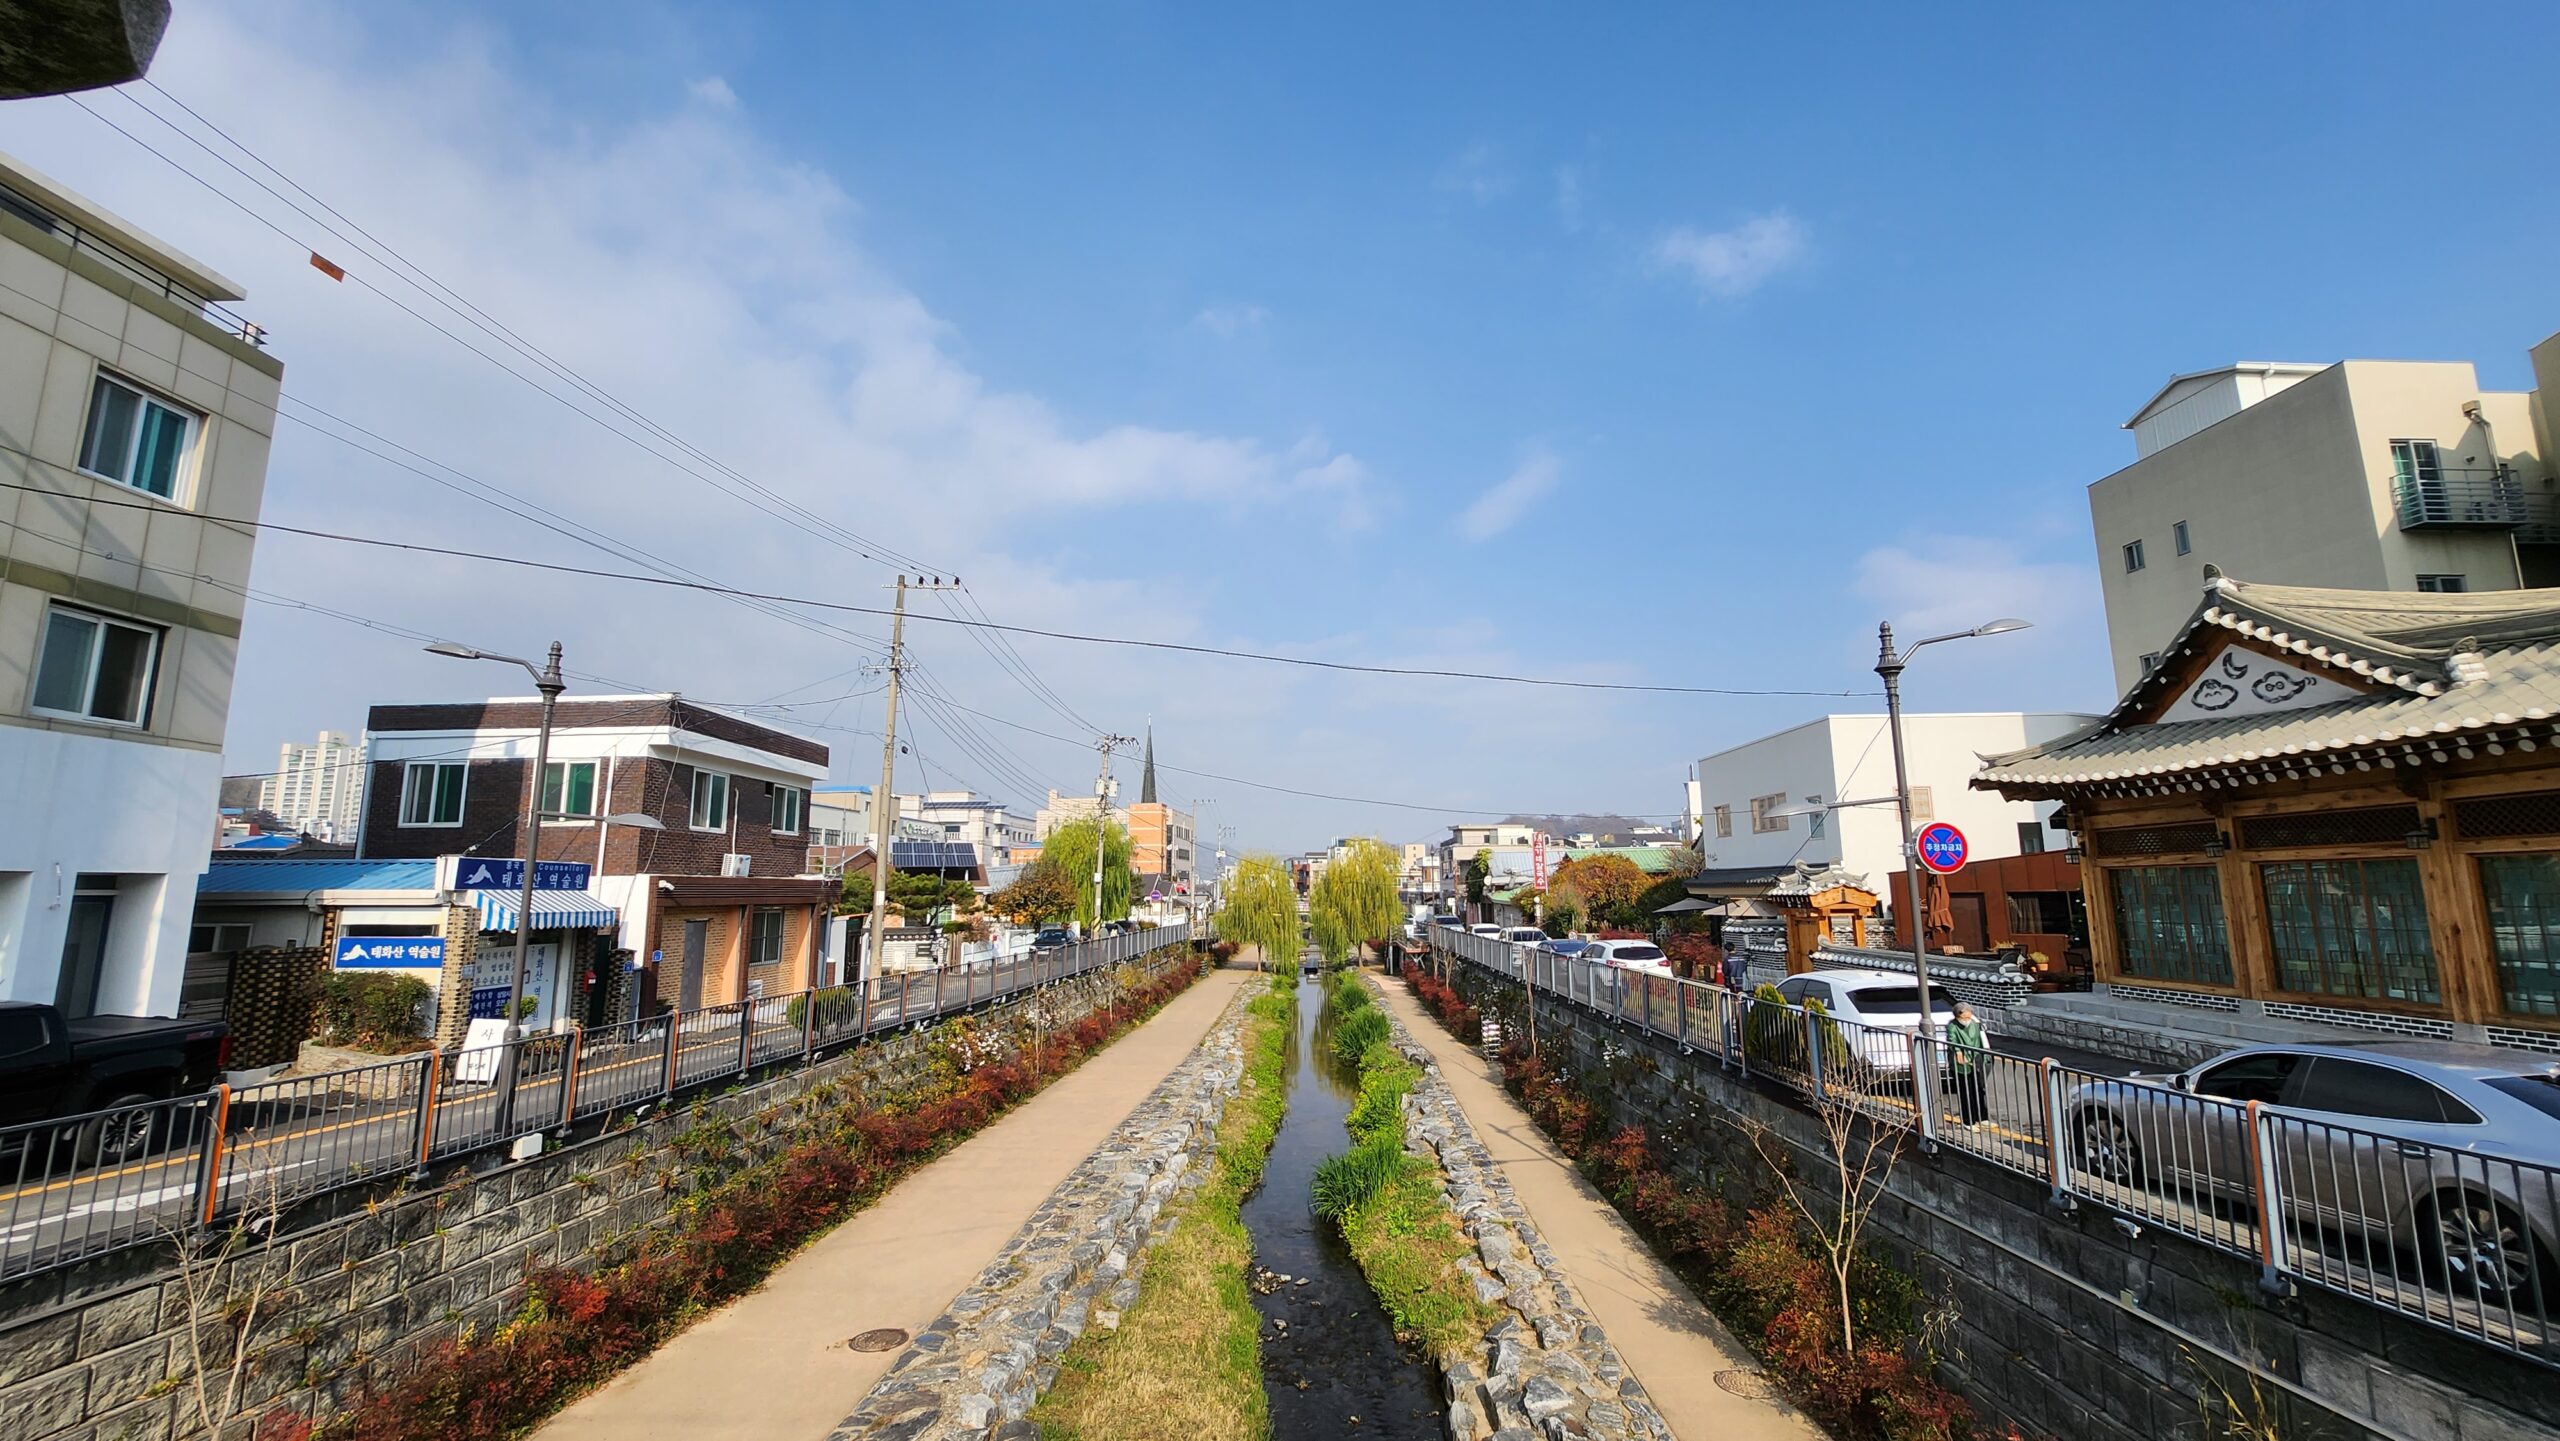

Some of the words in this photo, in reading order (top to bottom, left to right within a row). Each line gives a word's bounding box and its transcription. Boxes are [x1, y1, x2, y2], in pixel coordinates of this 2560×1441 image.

[1925, 843, 1962, 852] 주정차금지
[538, 863, 584, 872] Counsellor
[549, 873, 584, 889] 역술원
[371, 945, 405, 959] 태화산
[408, 945, 441, 959] 역술원
